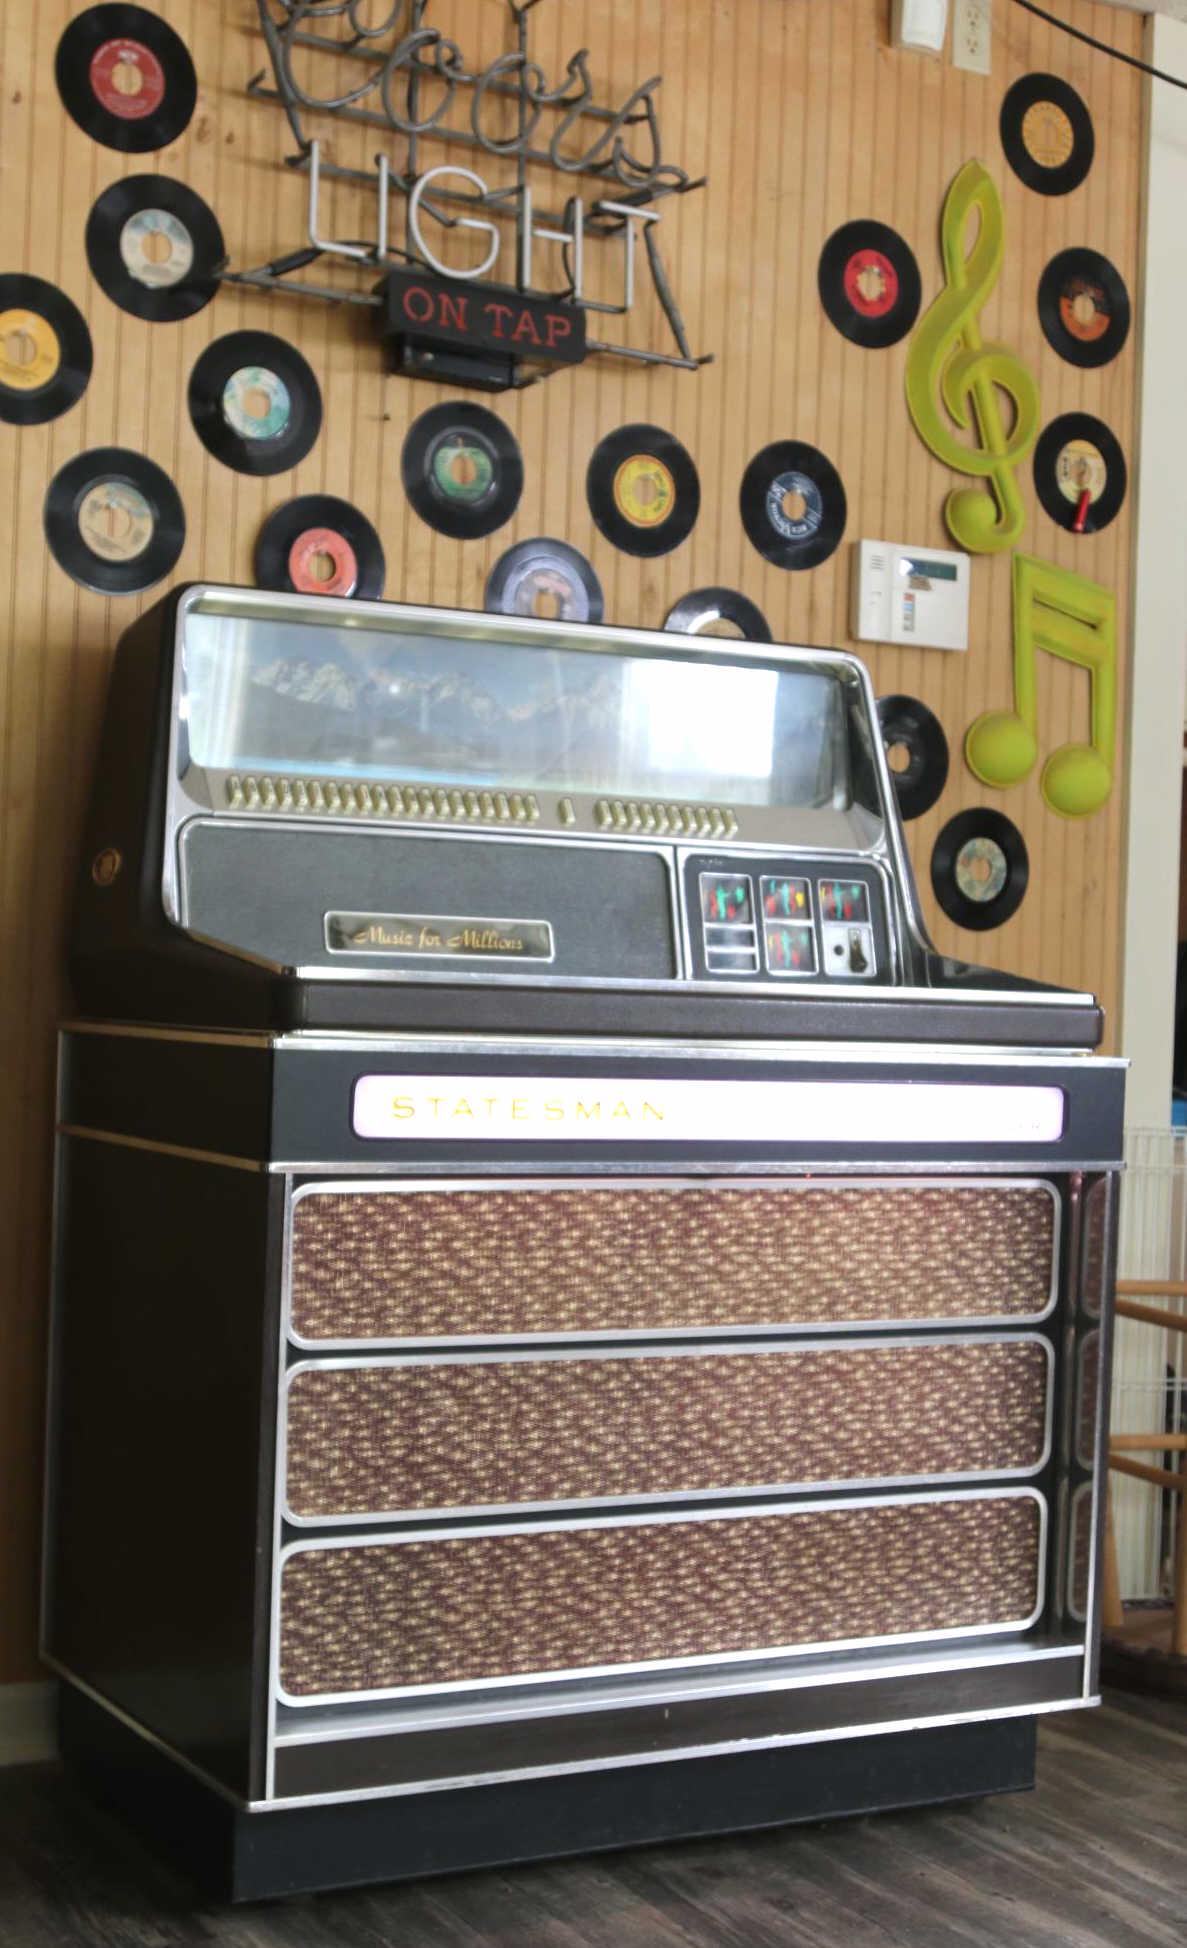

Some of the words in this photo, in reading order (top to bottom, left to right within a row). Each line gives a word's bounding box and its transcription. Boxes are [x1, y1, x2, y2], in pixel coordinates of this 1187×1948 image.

[309, 139, 662, 307] LIGHT
[402, 286, 468, 331] ON
[485, 304, 572, 348] TAP
[353, 925, 412, 946] Music
[418, 926, 441, 949] for
[446, 927, 523, 951] Millions
[391, 1096, 666, 1121] STATESMAN
